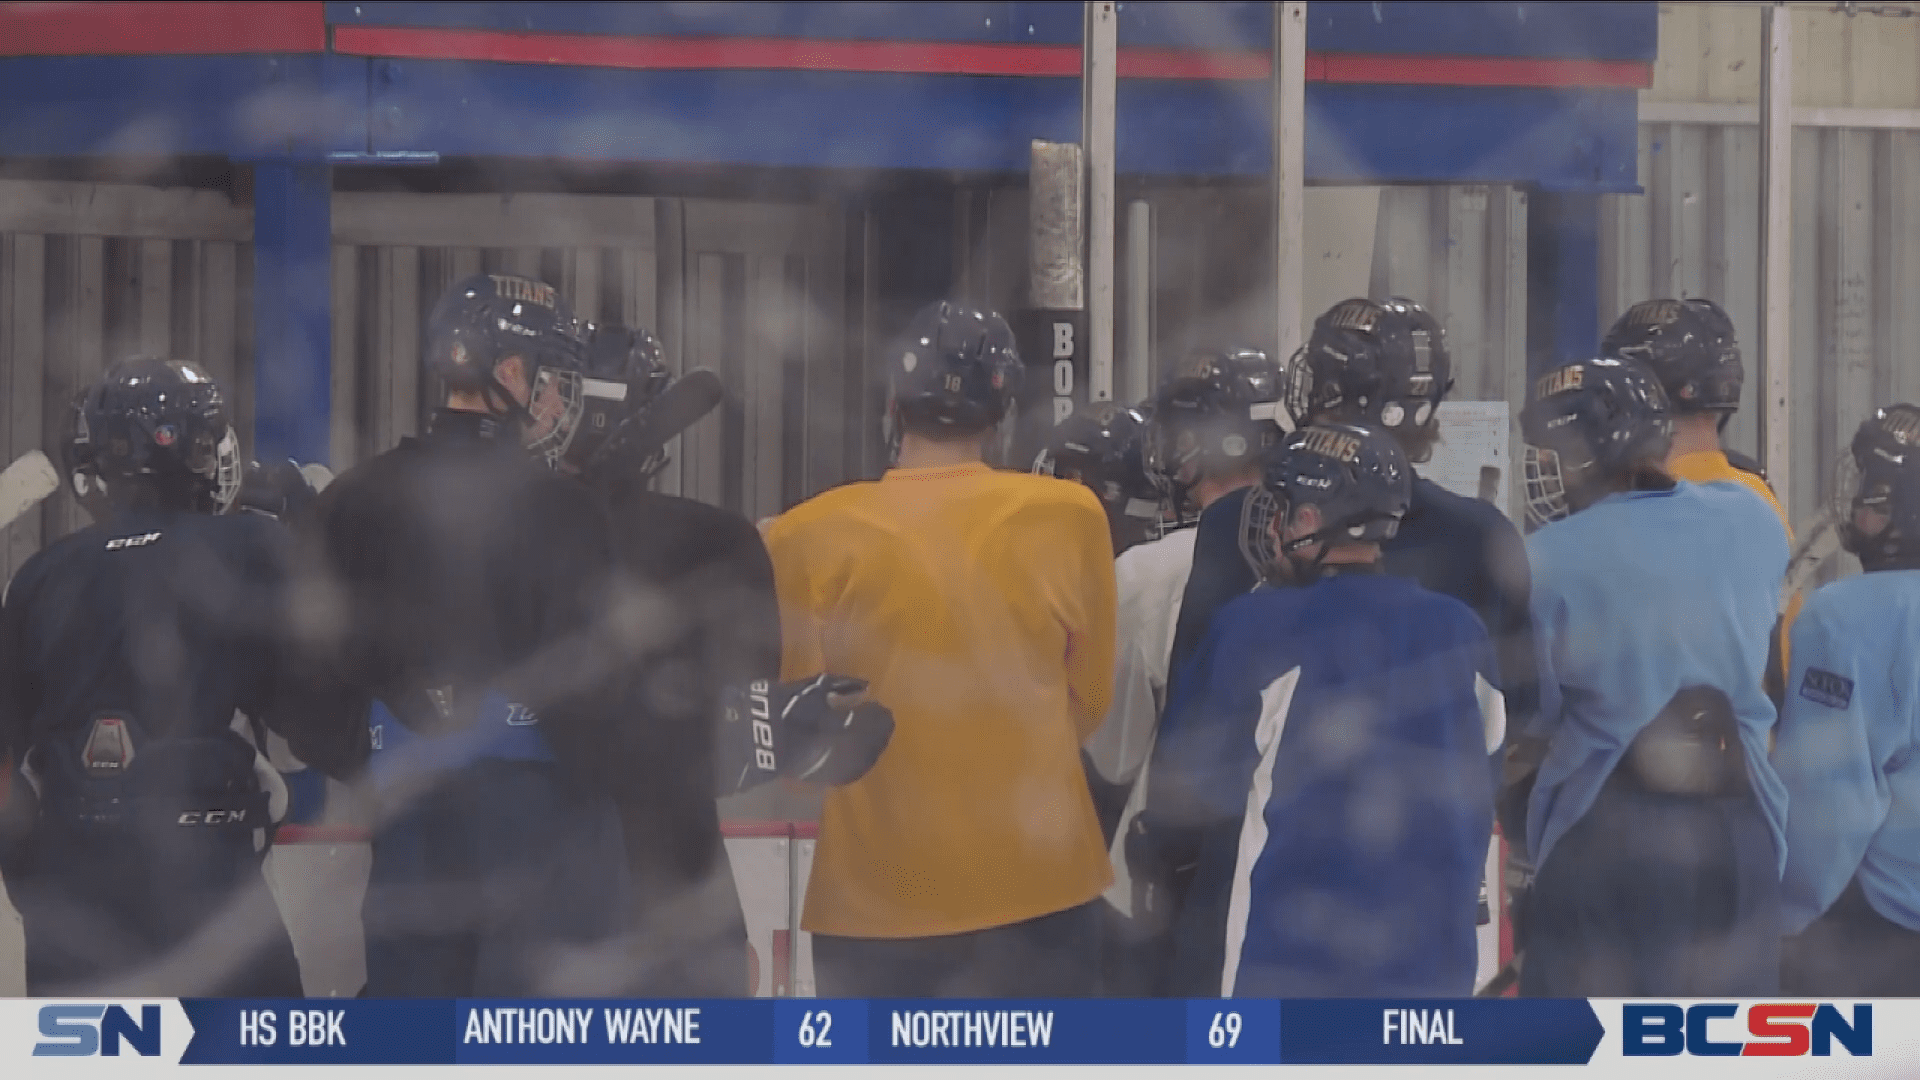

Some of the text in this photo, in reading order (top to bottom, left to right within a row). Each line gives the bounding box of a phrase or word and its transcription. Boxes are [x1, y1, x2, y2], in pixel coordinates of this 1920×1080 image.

[487, 274, 555, 307] TITANS
[944, 372, 961, 392] 18
[1536, 364, 1584, 401] TITANS
[1301, 426, 1361, 462] TITANS
[177, 809, 246, 824] CCM
